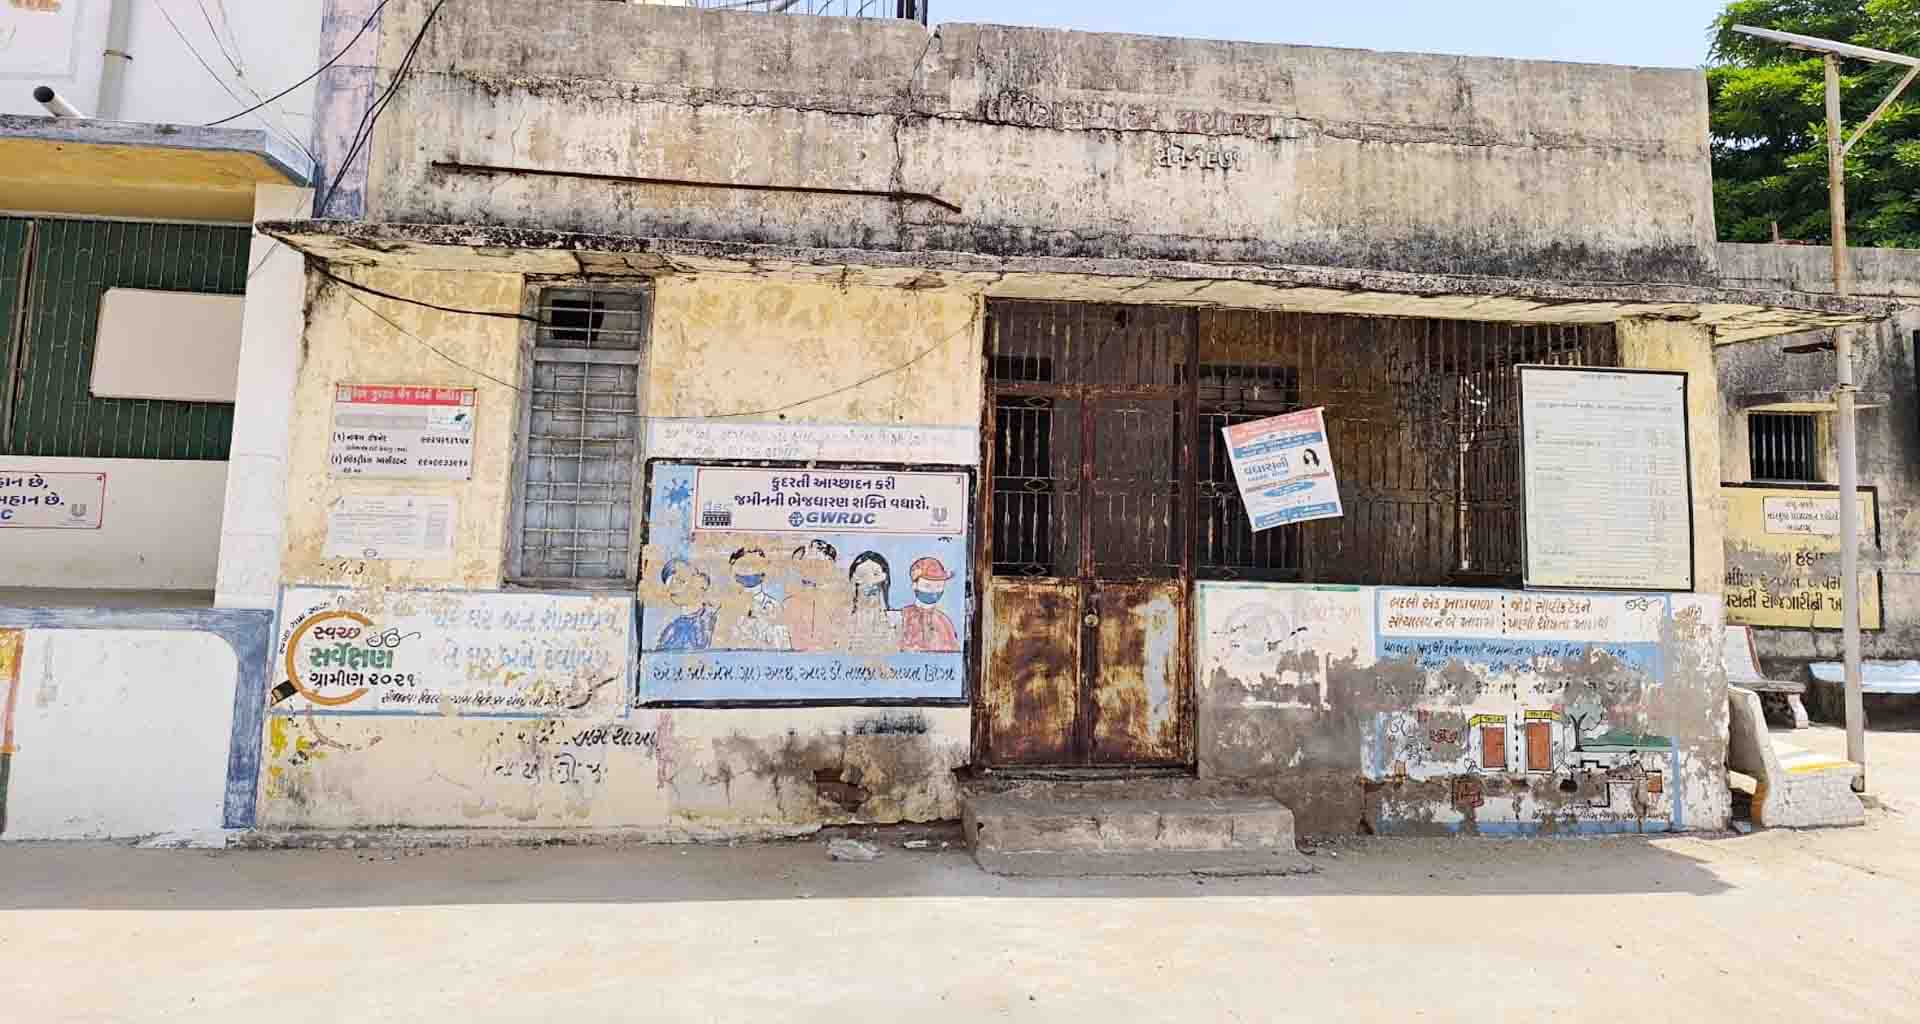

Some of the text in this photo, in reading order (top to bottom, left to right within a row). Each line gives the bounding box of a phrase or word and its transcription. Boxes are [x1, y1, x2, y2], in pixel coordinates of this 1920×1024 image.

[771, 474, 896, 492] કુદરતી આચ્છાદન કરી
[734, 491, 785, 507] જમીનની
[787, 492, 849, 508] ભેજધારણ
[852, 493, 887, 509] શક્તિ
[806, 511, 877, 526] GWRDC
[312, 626, 361, 641] સ્વચ્છ
[309, 670, 416, 688] ગ્રામીણ ૨૦૨૧
